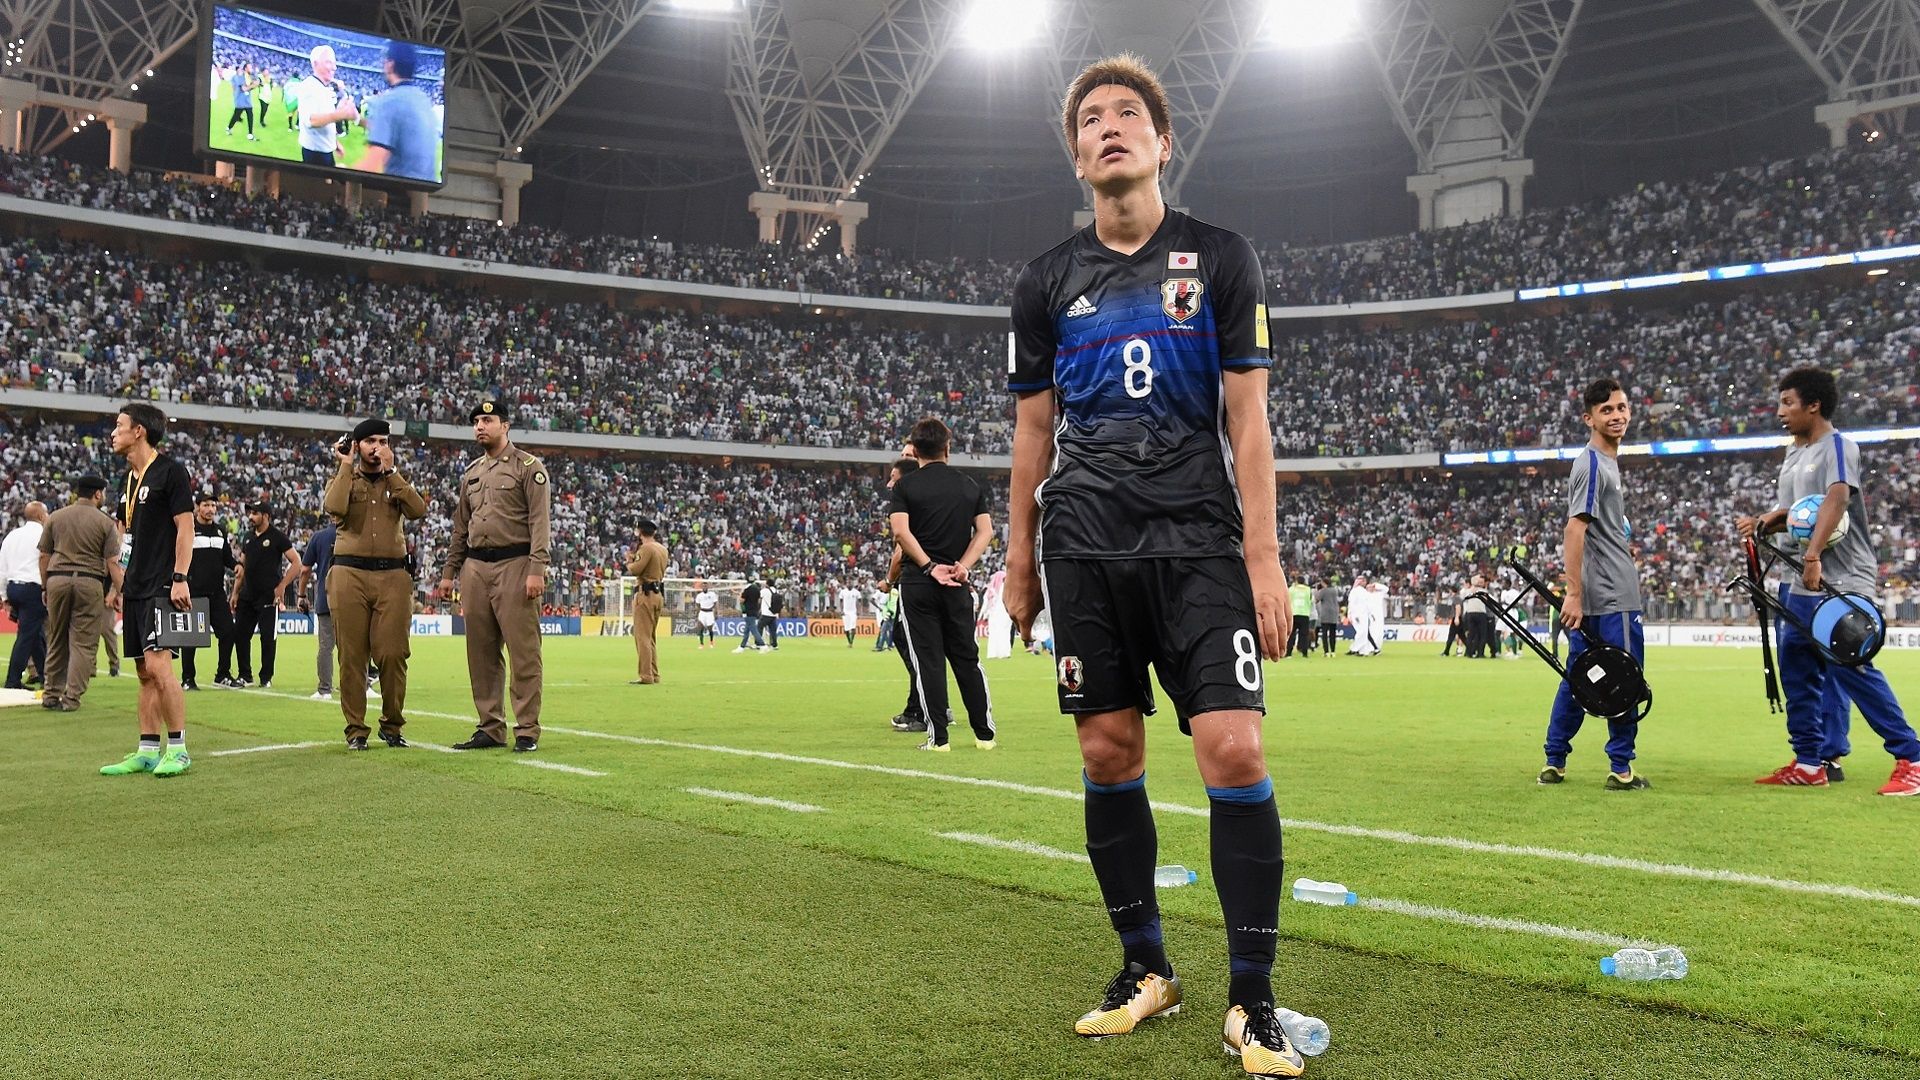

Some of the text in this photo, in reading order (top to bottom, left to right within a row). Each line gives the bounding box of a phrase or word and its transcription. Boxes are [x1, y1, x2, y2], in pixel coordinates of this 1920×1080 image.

[1067, 306, 1097, 317] adidas
[1123, 339, 1153, 399] 8
[809, 621, 875, 637] Continntal
[1412, 627, 1438, 641] au
[1233, 628, 1260, 692] 8
